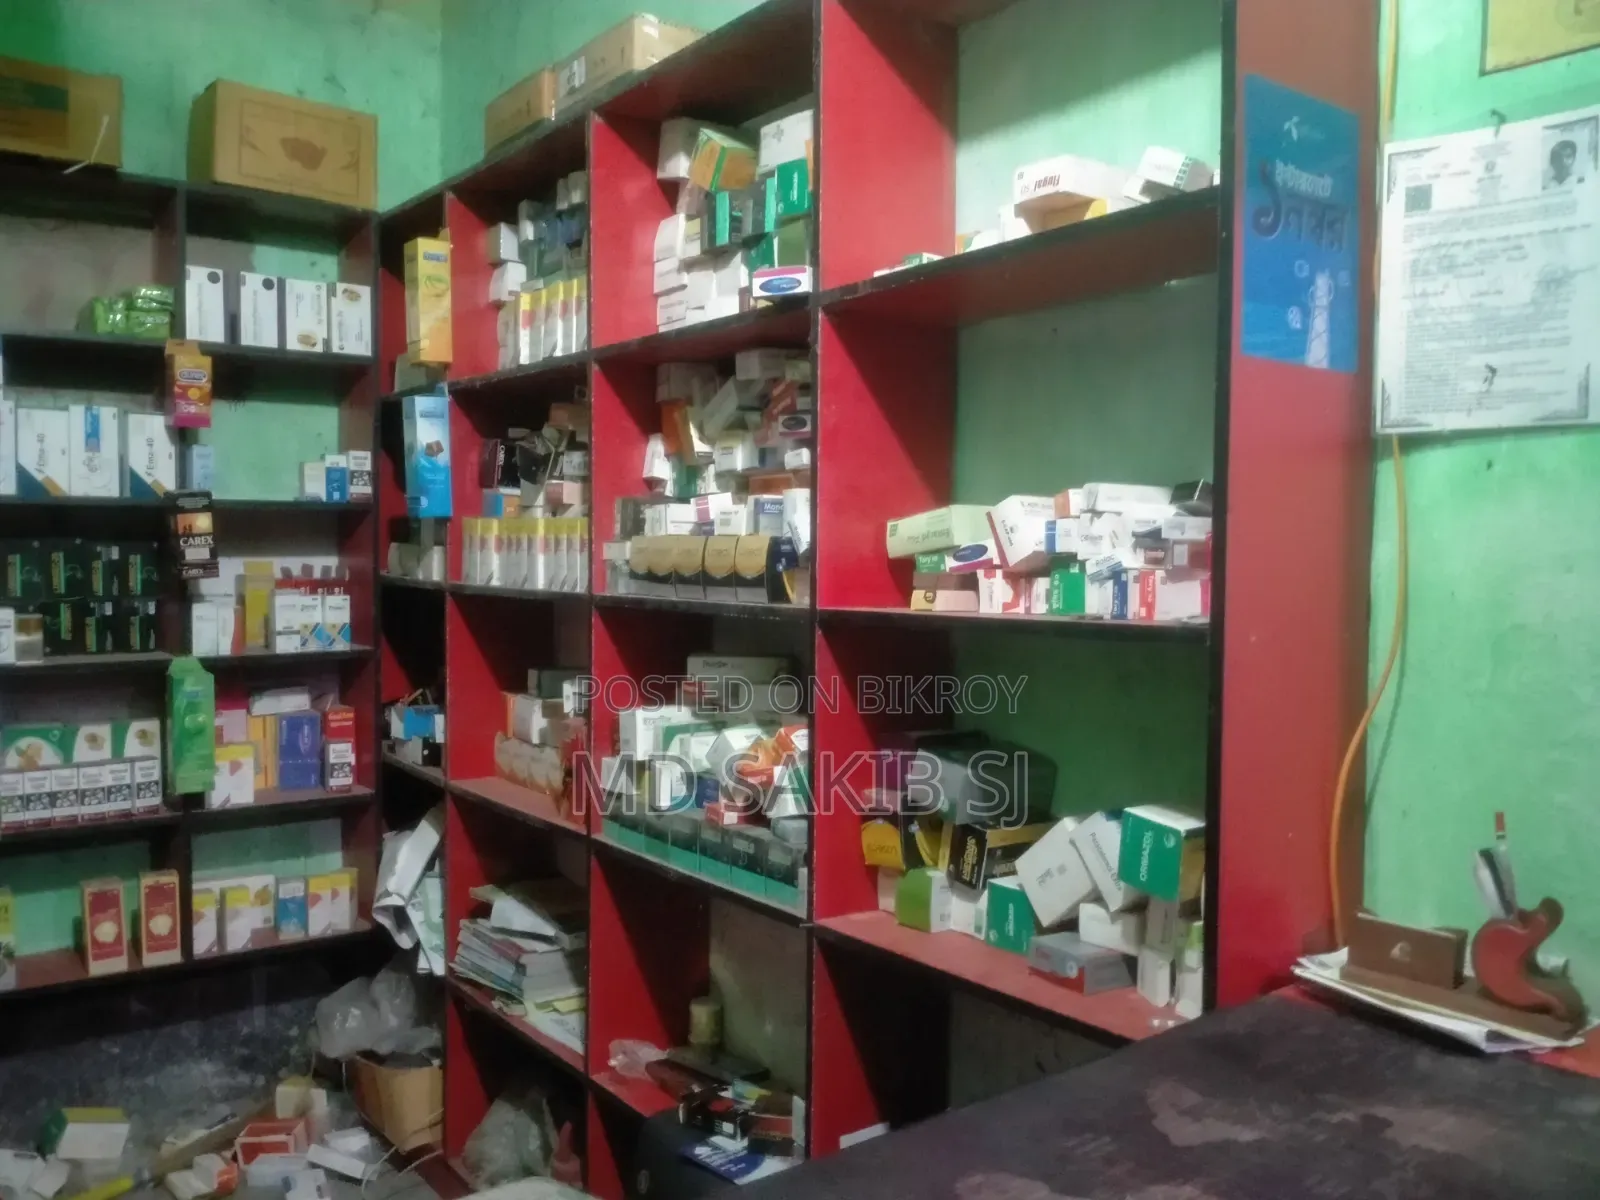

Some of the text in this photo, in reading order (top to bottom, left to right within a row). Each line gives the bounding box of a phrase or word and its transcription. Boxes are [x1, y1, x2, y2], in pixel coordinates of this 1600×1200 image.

[1033, 173, 1061, 193] Flugal
[180, 535, 214, 547] CAREX
[182, 568, 204, 577] CAREX
